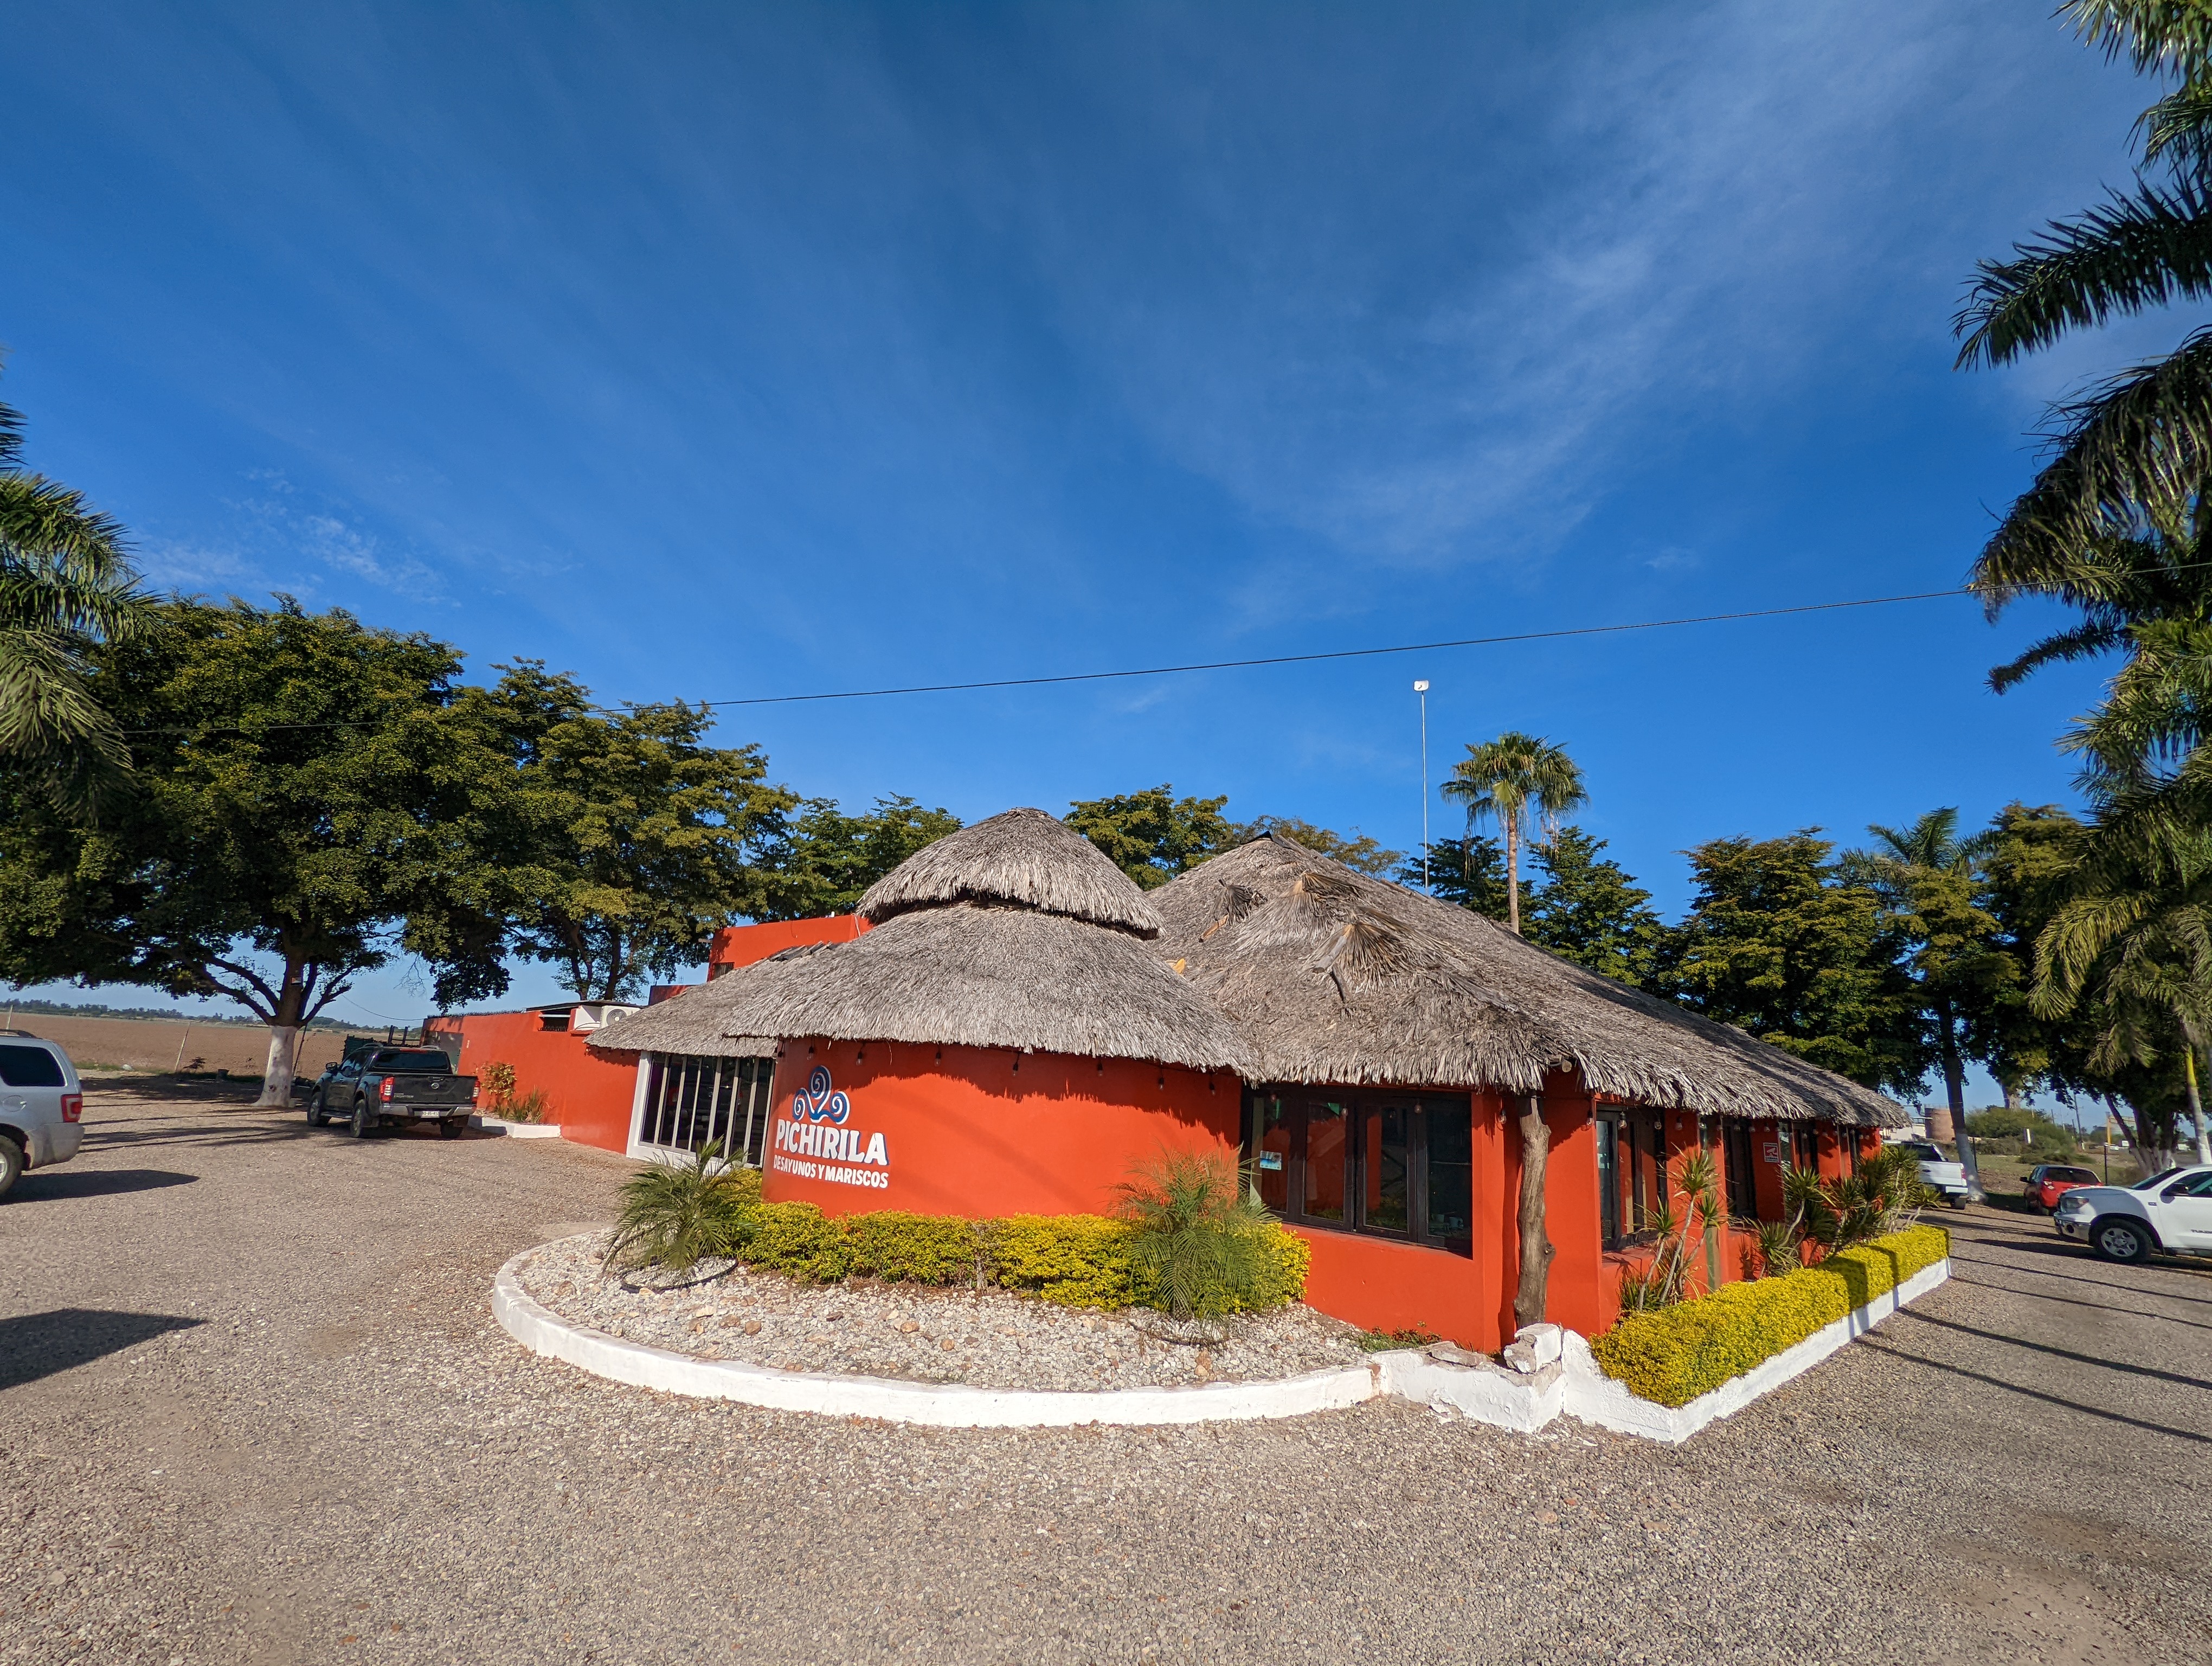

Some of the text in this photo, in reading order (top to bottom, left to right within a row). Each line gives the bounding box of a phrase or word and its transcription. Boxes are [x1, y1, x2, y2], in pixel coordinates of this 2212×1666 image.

[775, 1119, 889, 1165] PICHIRILA
[774, 1154, 889, 1188] DESAYUNOS Y MARISCOS
